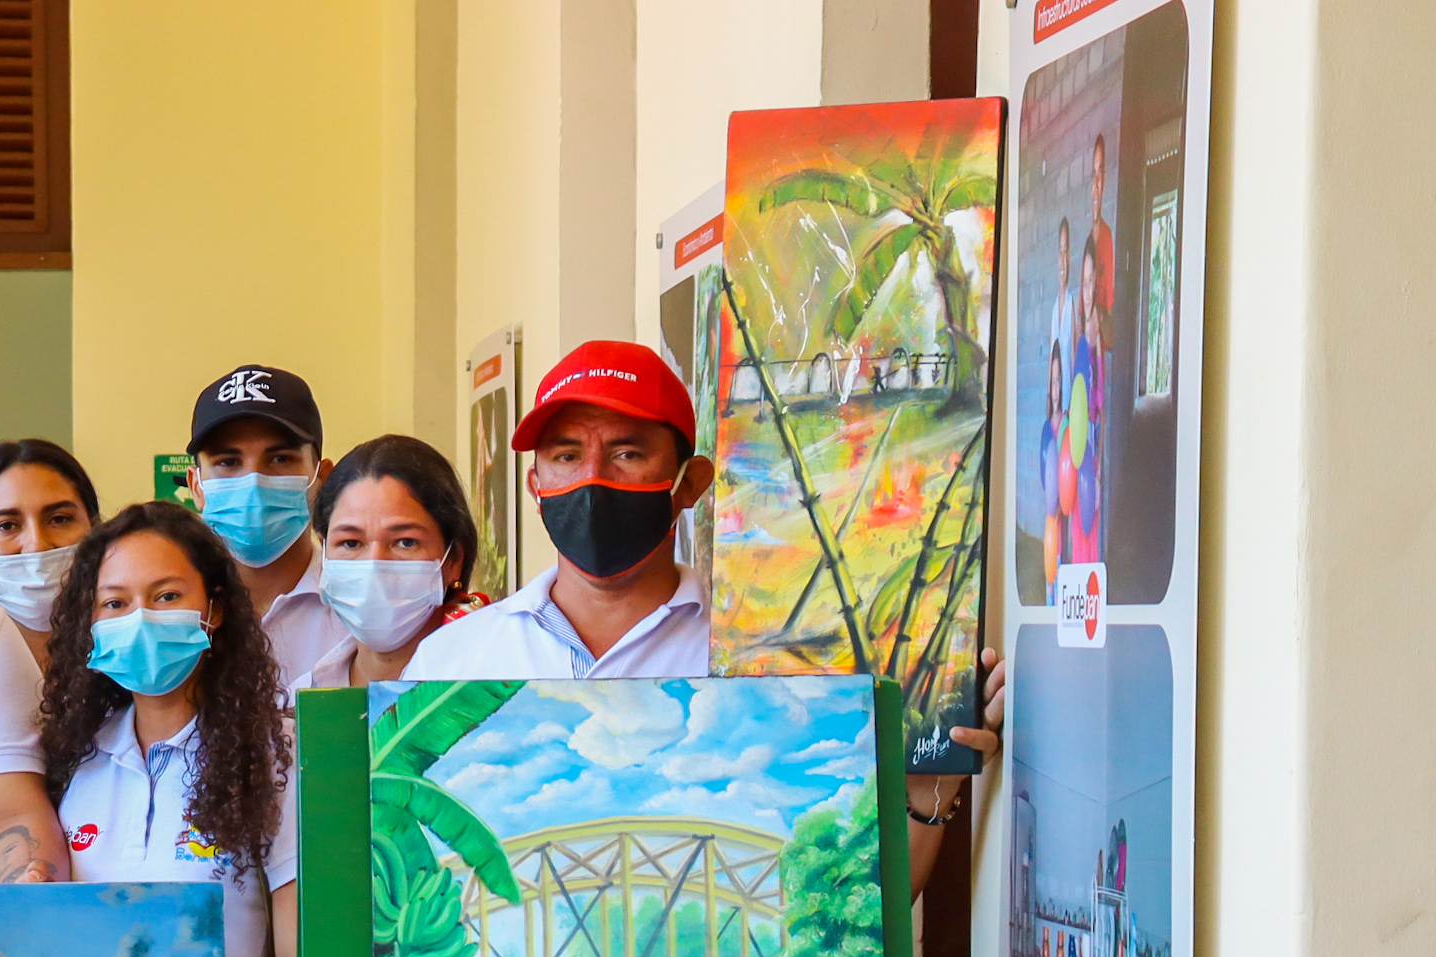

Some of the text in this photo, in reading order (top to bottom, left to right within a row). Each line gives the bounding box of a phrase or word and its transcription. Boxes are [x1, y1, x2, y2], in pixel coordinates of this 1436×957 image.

[541, 368, 638, 403] TOMMY HILFIGER
[169, 456, 189, 464] RUTA
